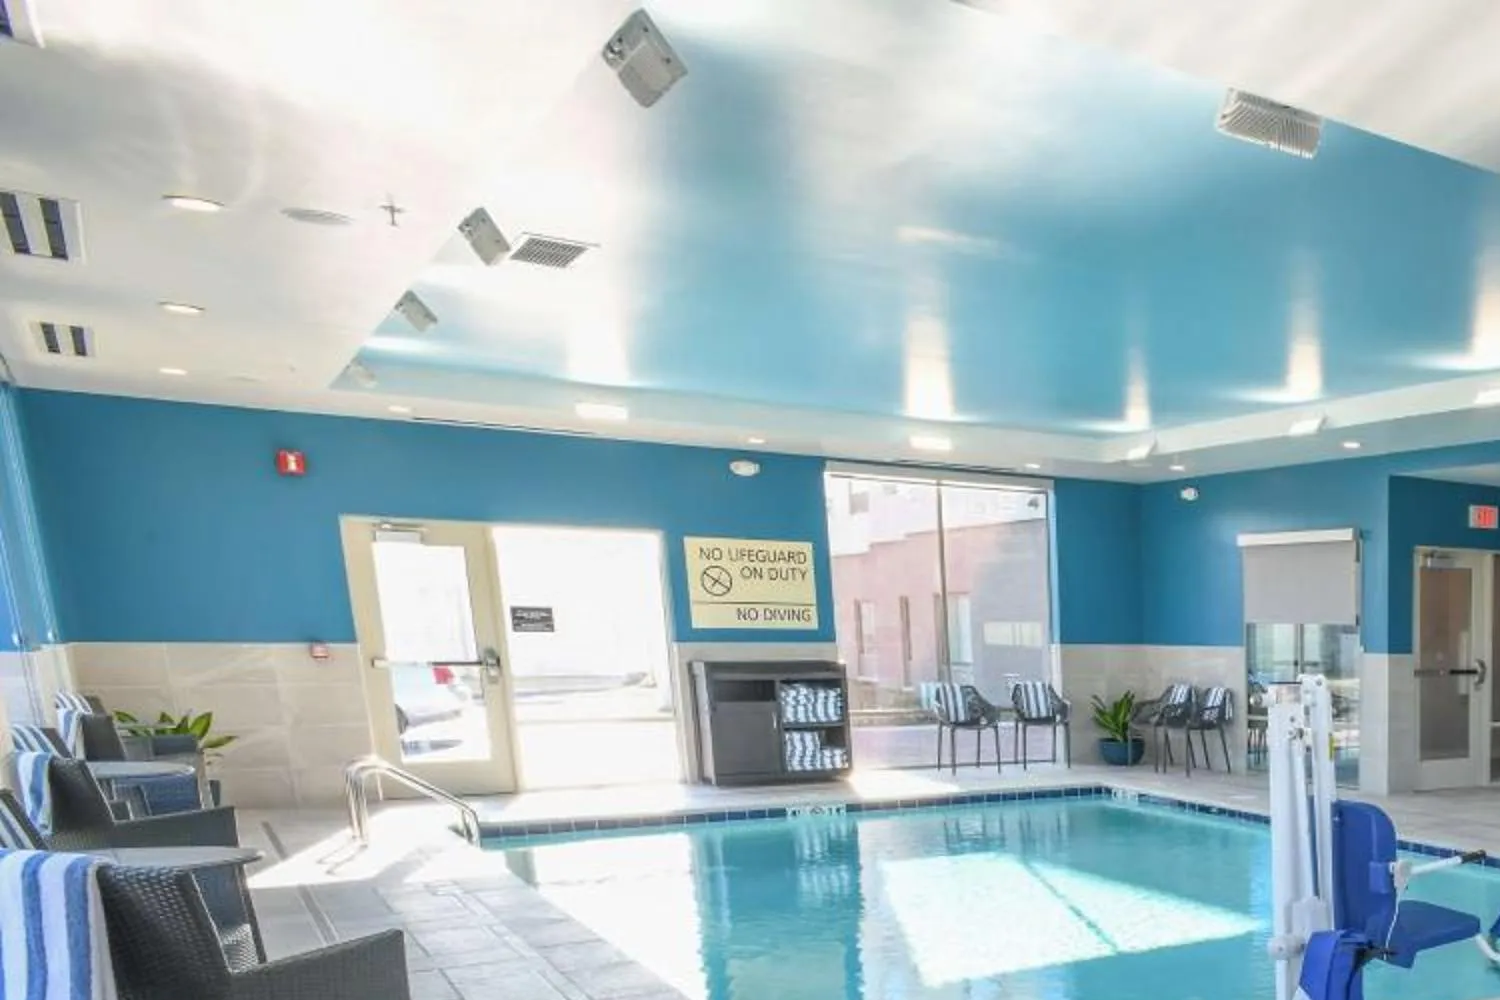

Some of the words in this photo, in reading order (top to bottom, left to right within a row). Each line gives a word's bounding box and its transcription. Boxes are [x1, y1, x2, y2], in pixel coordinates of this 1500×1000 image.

[699, 547, 723, 561] NO
[728, 547, 807, 565] LIFEGUARD
[740, 565, 763, 580] ON
[767, 567, 808, 581] DUTY
[736, 607, 759, 621] NO
[763, 608, 811, 623] DIVING
